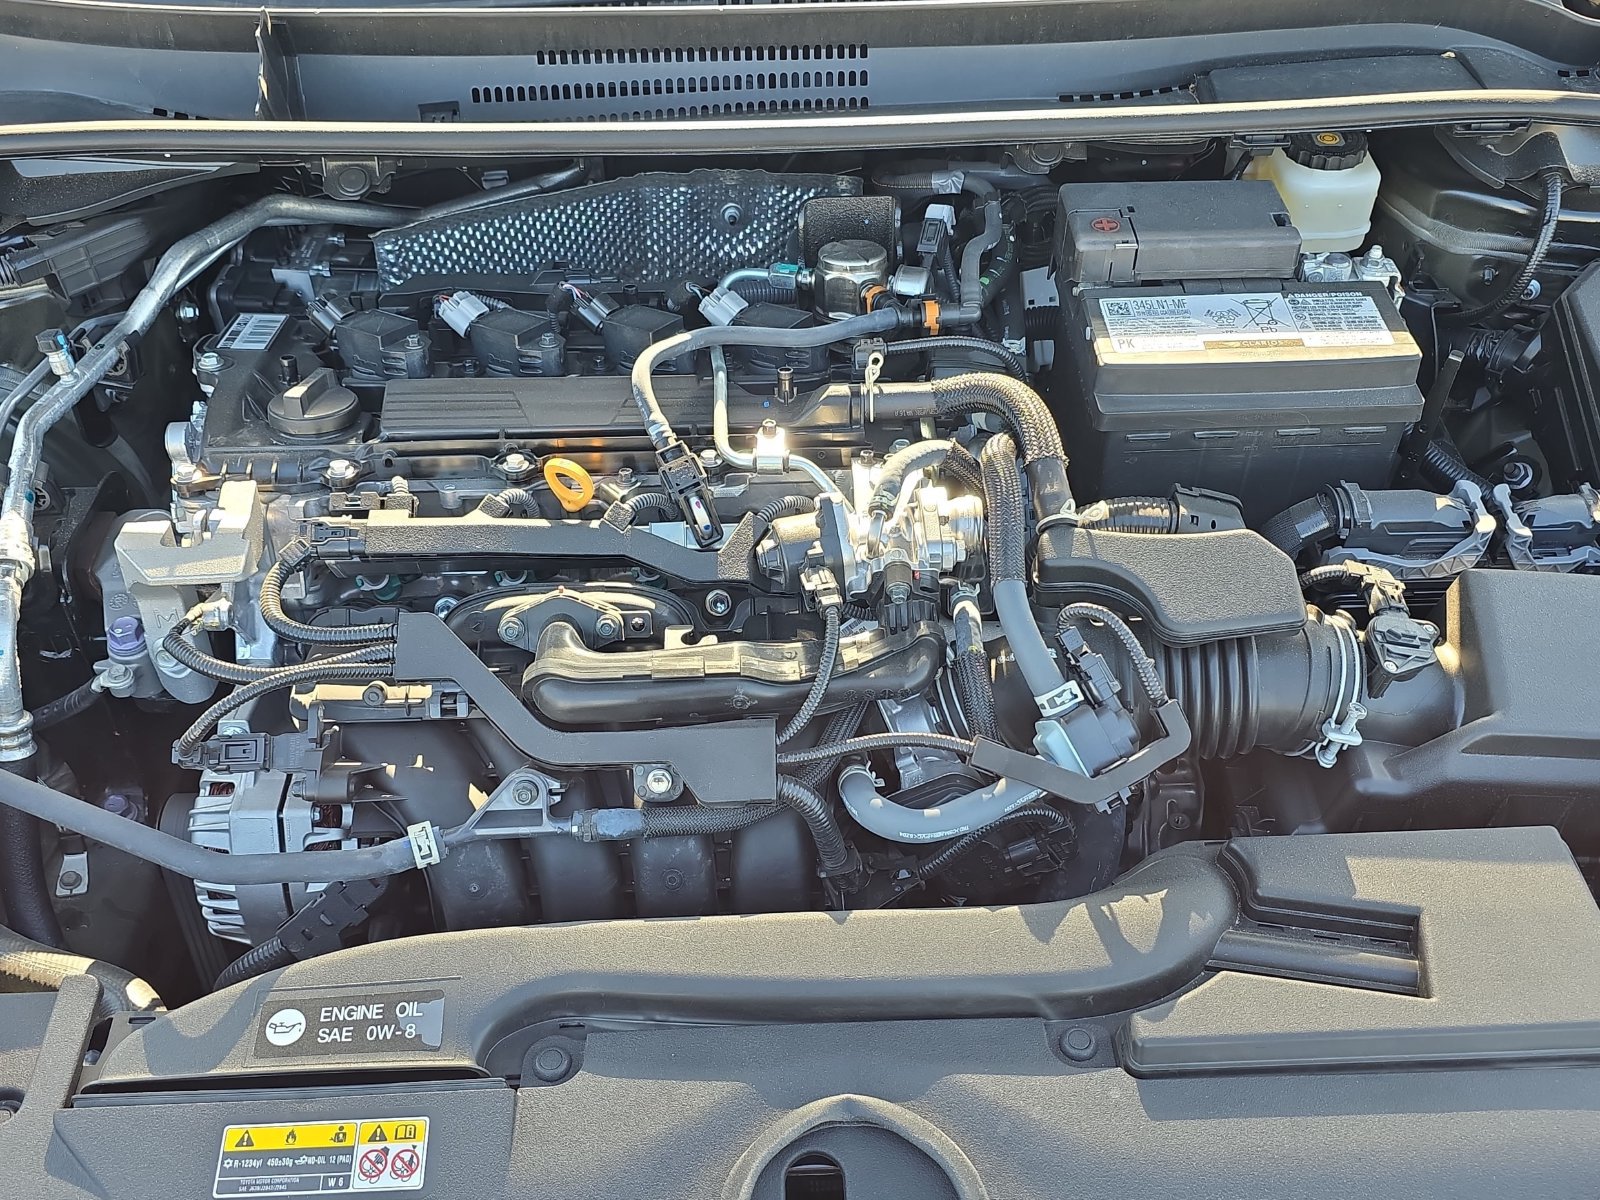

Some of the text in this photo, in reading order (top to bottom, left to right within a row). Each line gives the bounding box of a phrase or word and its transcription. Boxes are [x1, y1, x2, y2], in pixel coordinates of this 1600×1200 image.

[1133, 299, 1187, 310] 345LN1-MF
[1117, 338, 1135, 349] PK
[320, 1001, 423, 1022] ENGINE OIL
[317, 1023, 416, 1043] SAE 0W-8
[233, 1158, 263, 1168] R-1234yf
[329, 1155, 336, 1164] 12
[336, 1154, 352, 1165] (PAG)
[328, 1178, 336, 1187] W
